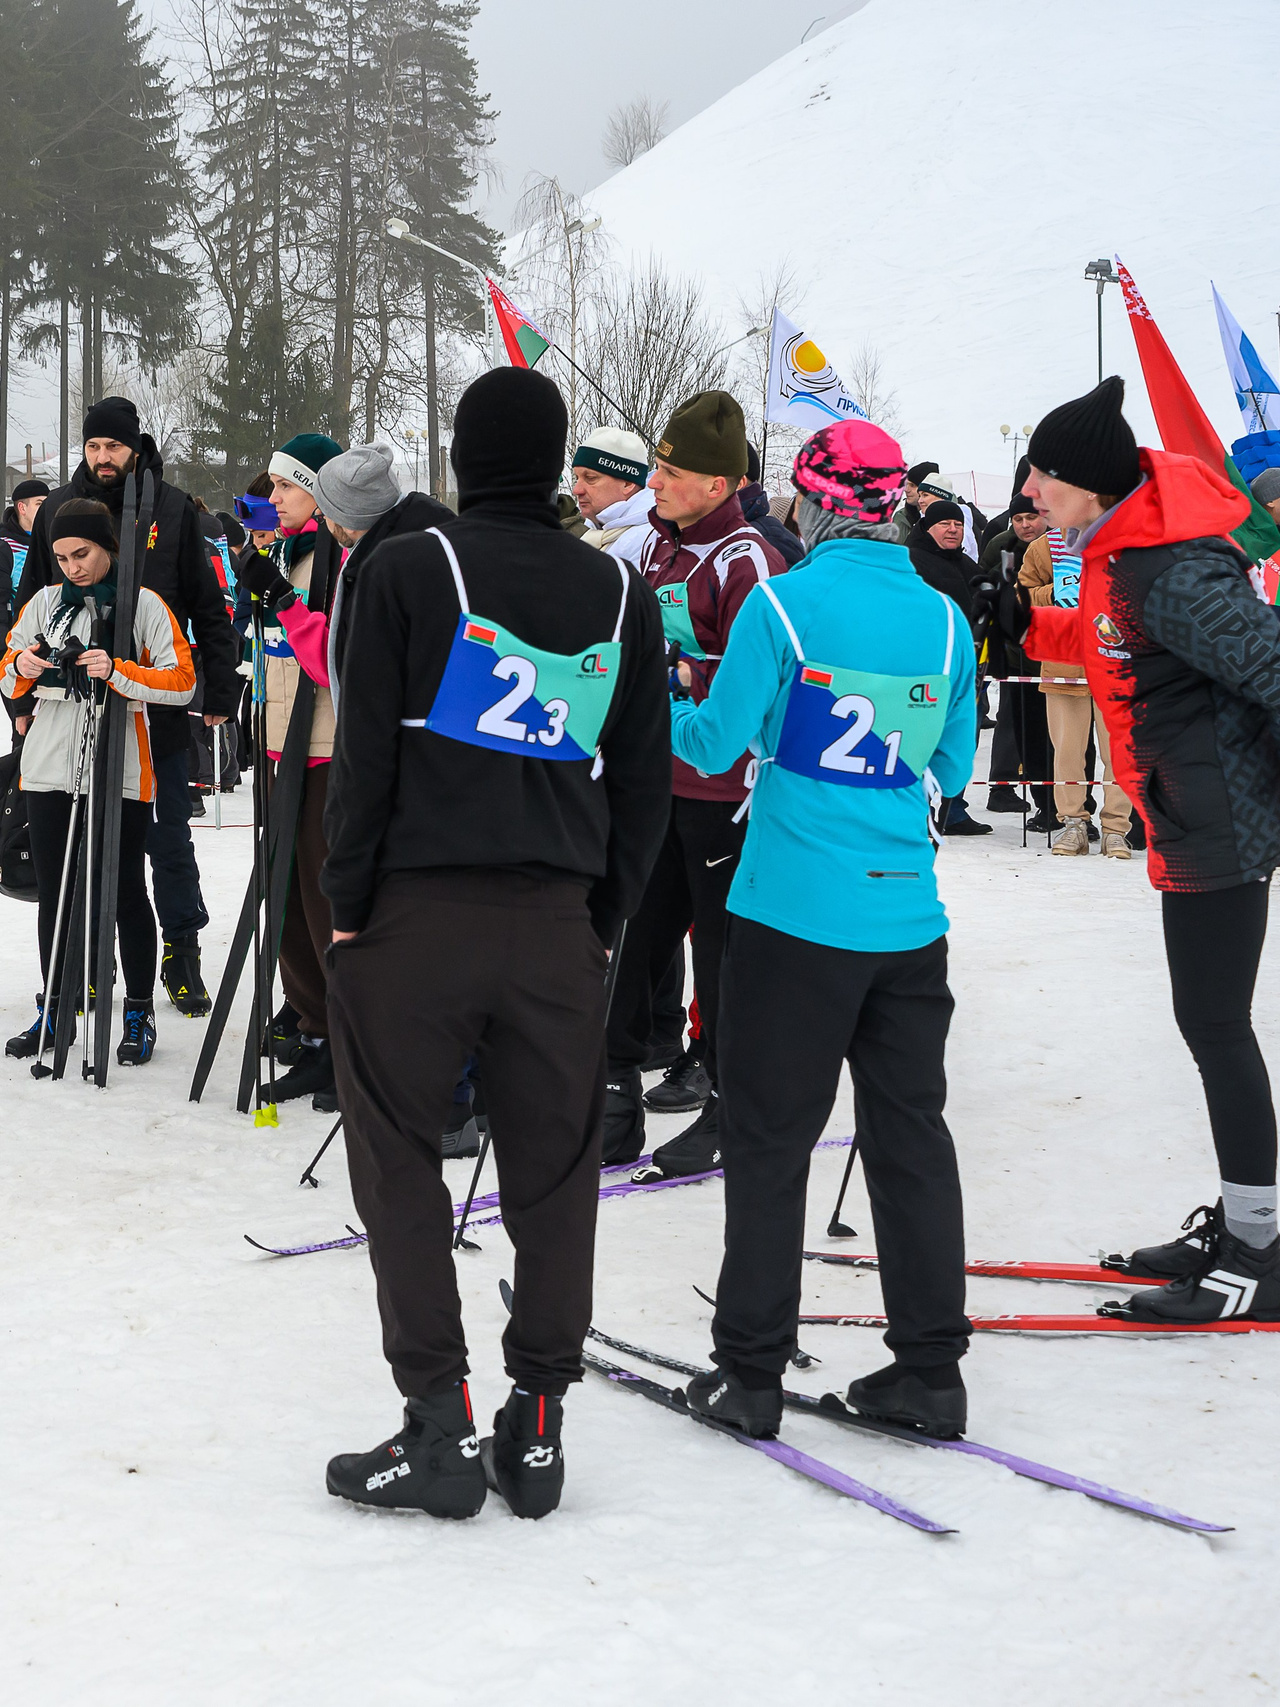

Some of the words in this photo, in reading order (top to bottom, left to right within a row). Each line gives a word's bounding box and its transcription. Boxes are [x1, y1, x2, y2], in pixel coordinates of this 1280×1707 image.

[292, 470, 314, 491] БЕЛА
[598, 457, 640, 477] БЕЛАРУСЬ
[476, 654, 570, 747] 2.3
[818, 693, 903, 776] 2.1
[365, 1461, 412, 1492] alpina
